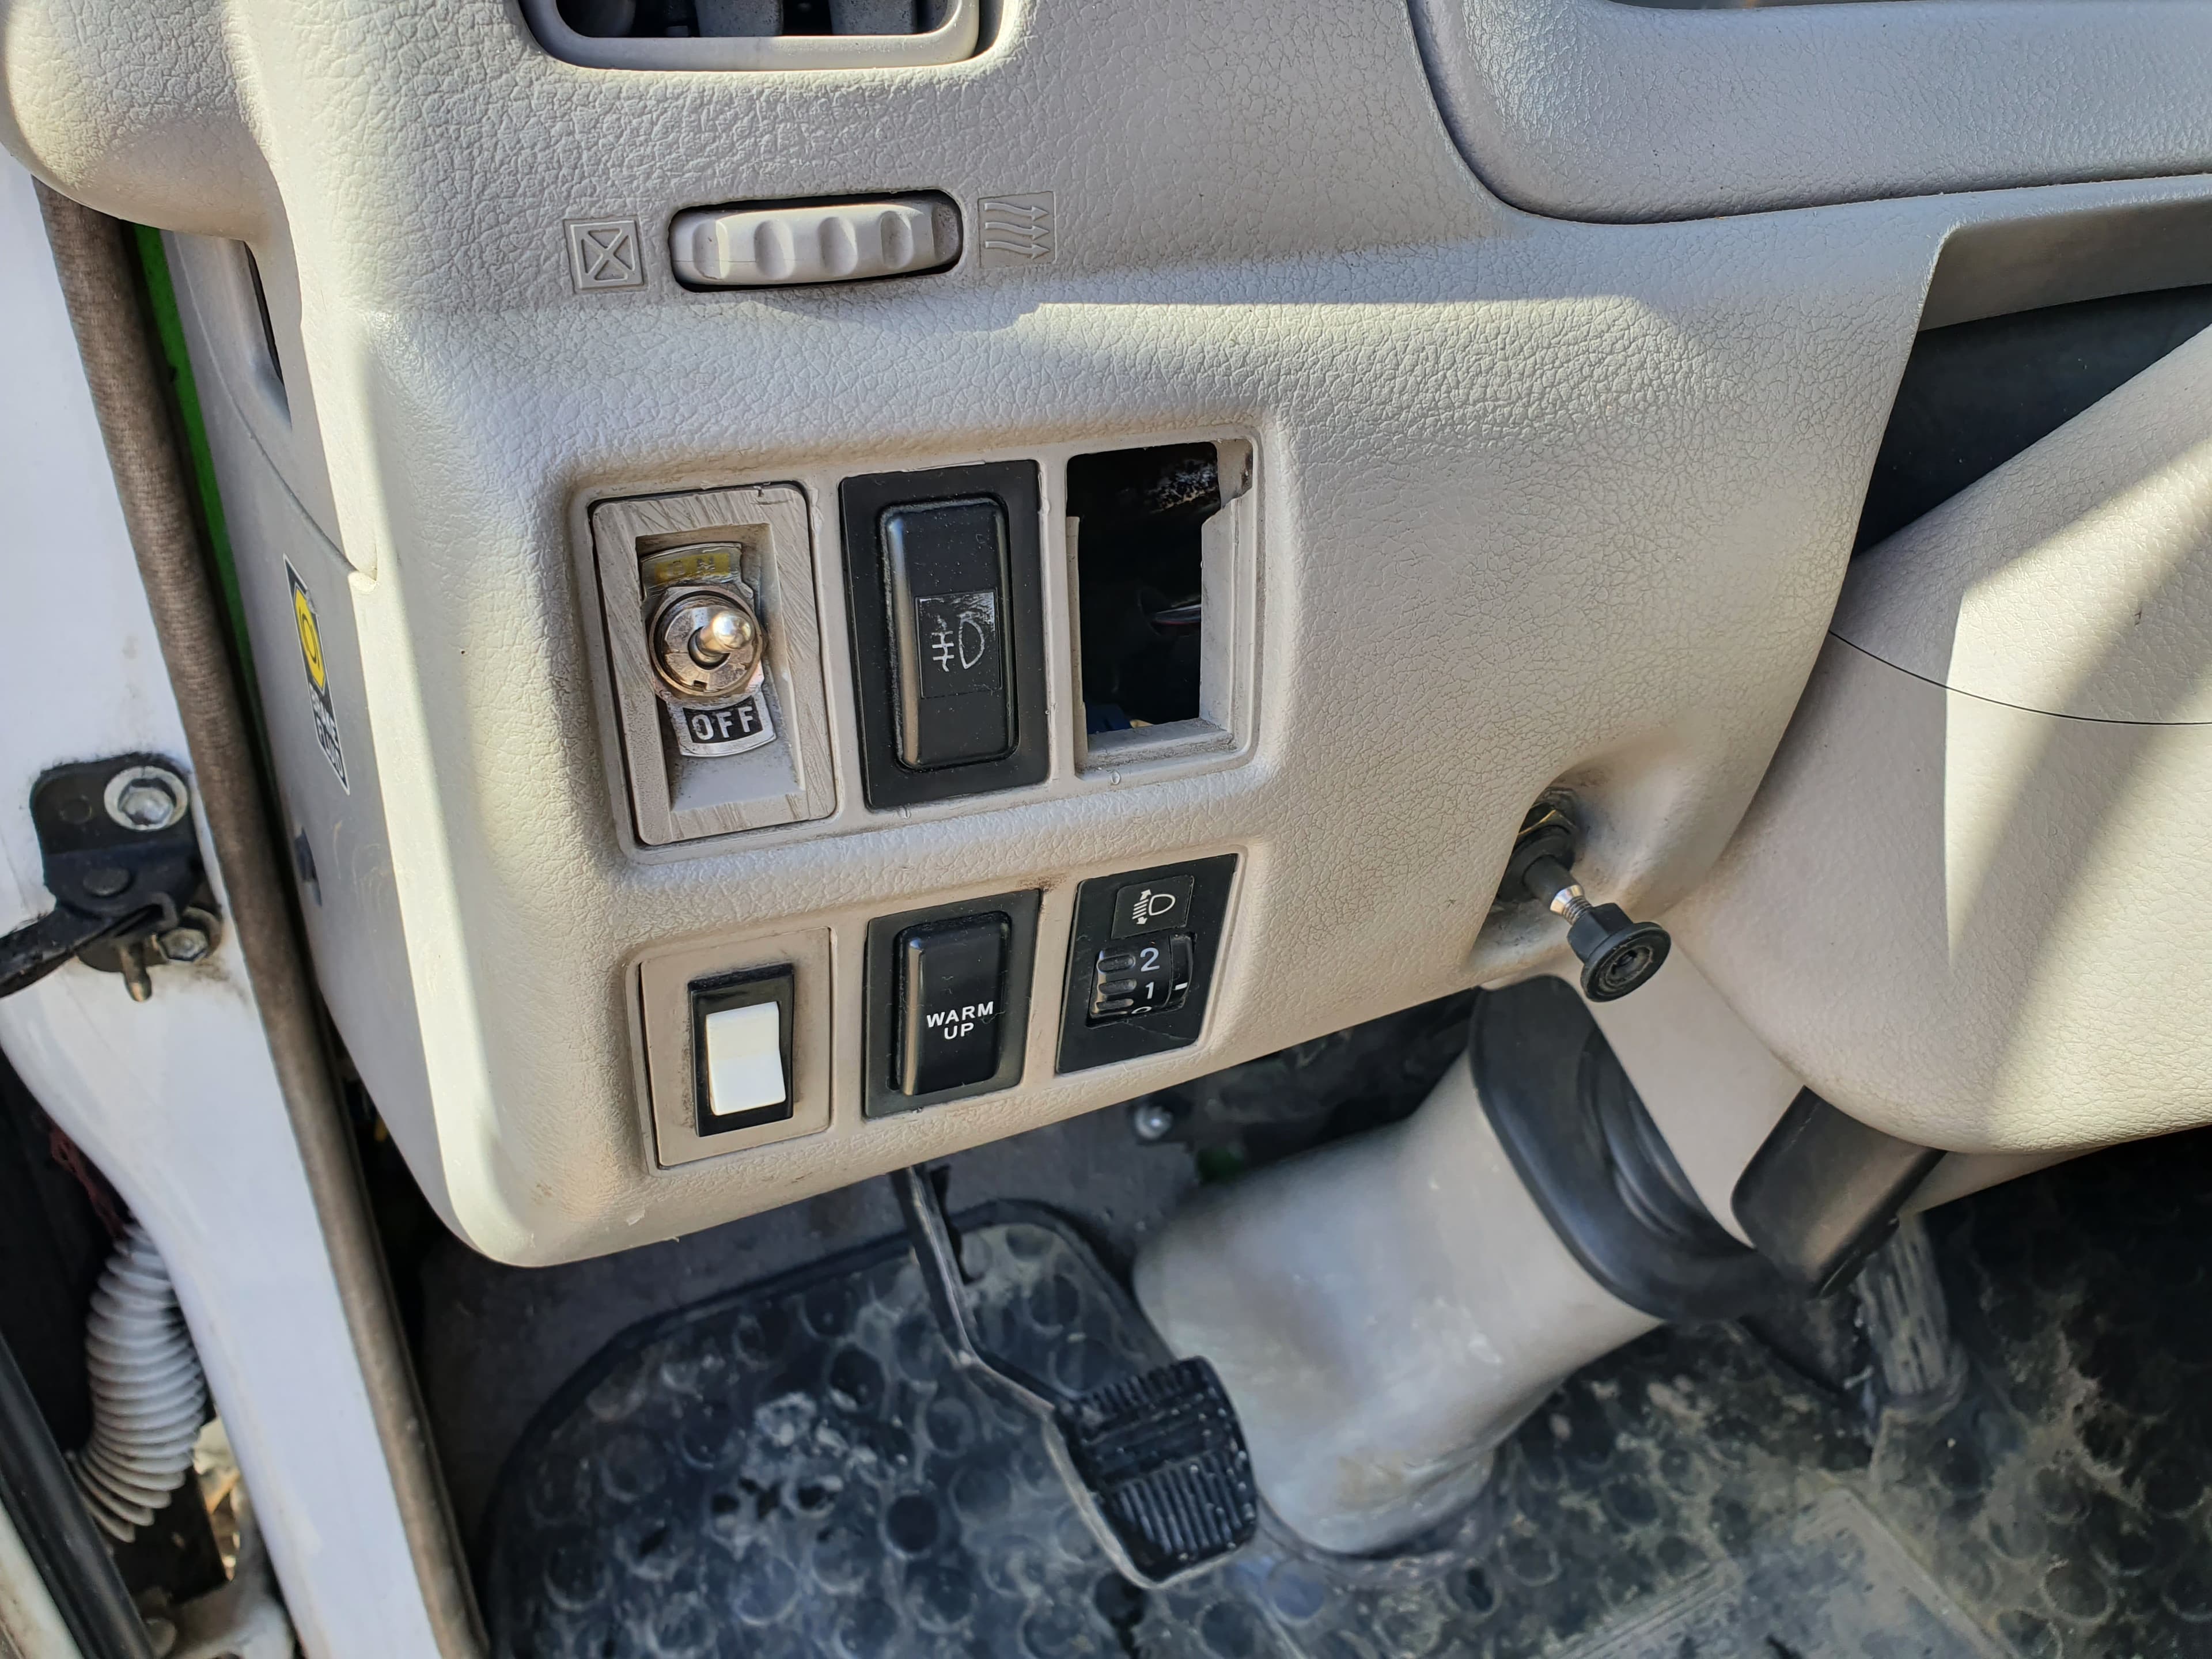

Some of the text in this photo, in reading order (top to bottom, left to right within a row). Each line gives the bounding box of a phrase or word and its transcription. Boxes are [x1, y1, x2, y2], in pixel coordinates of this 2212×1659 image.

[692, 706, 754, 741] OFF
[1140, 948, 1160, 972] 2
[1145, 982, 1154, 999] 1
[926, 1001, 994, 1028] WARM
[944, 1022, 974, 1040] UP
